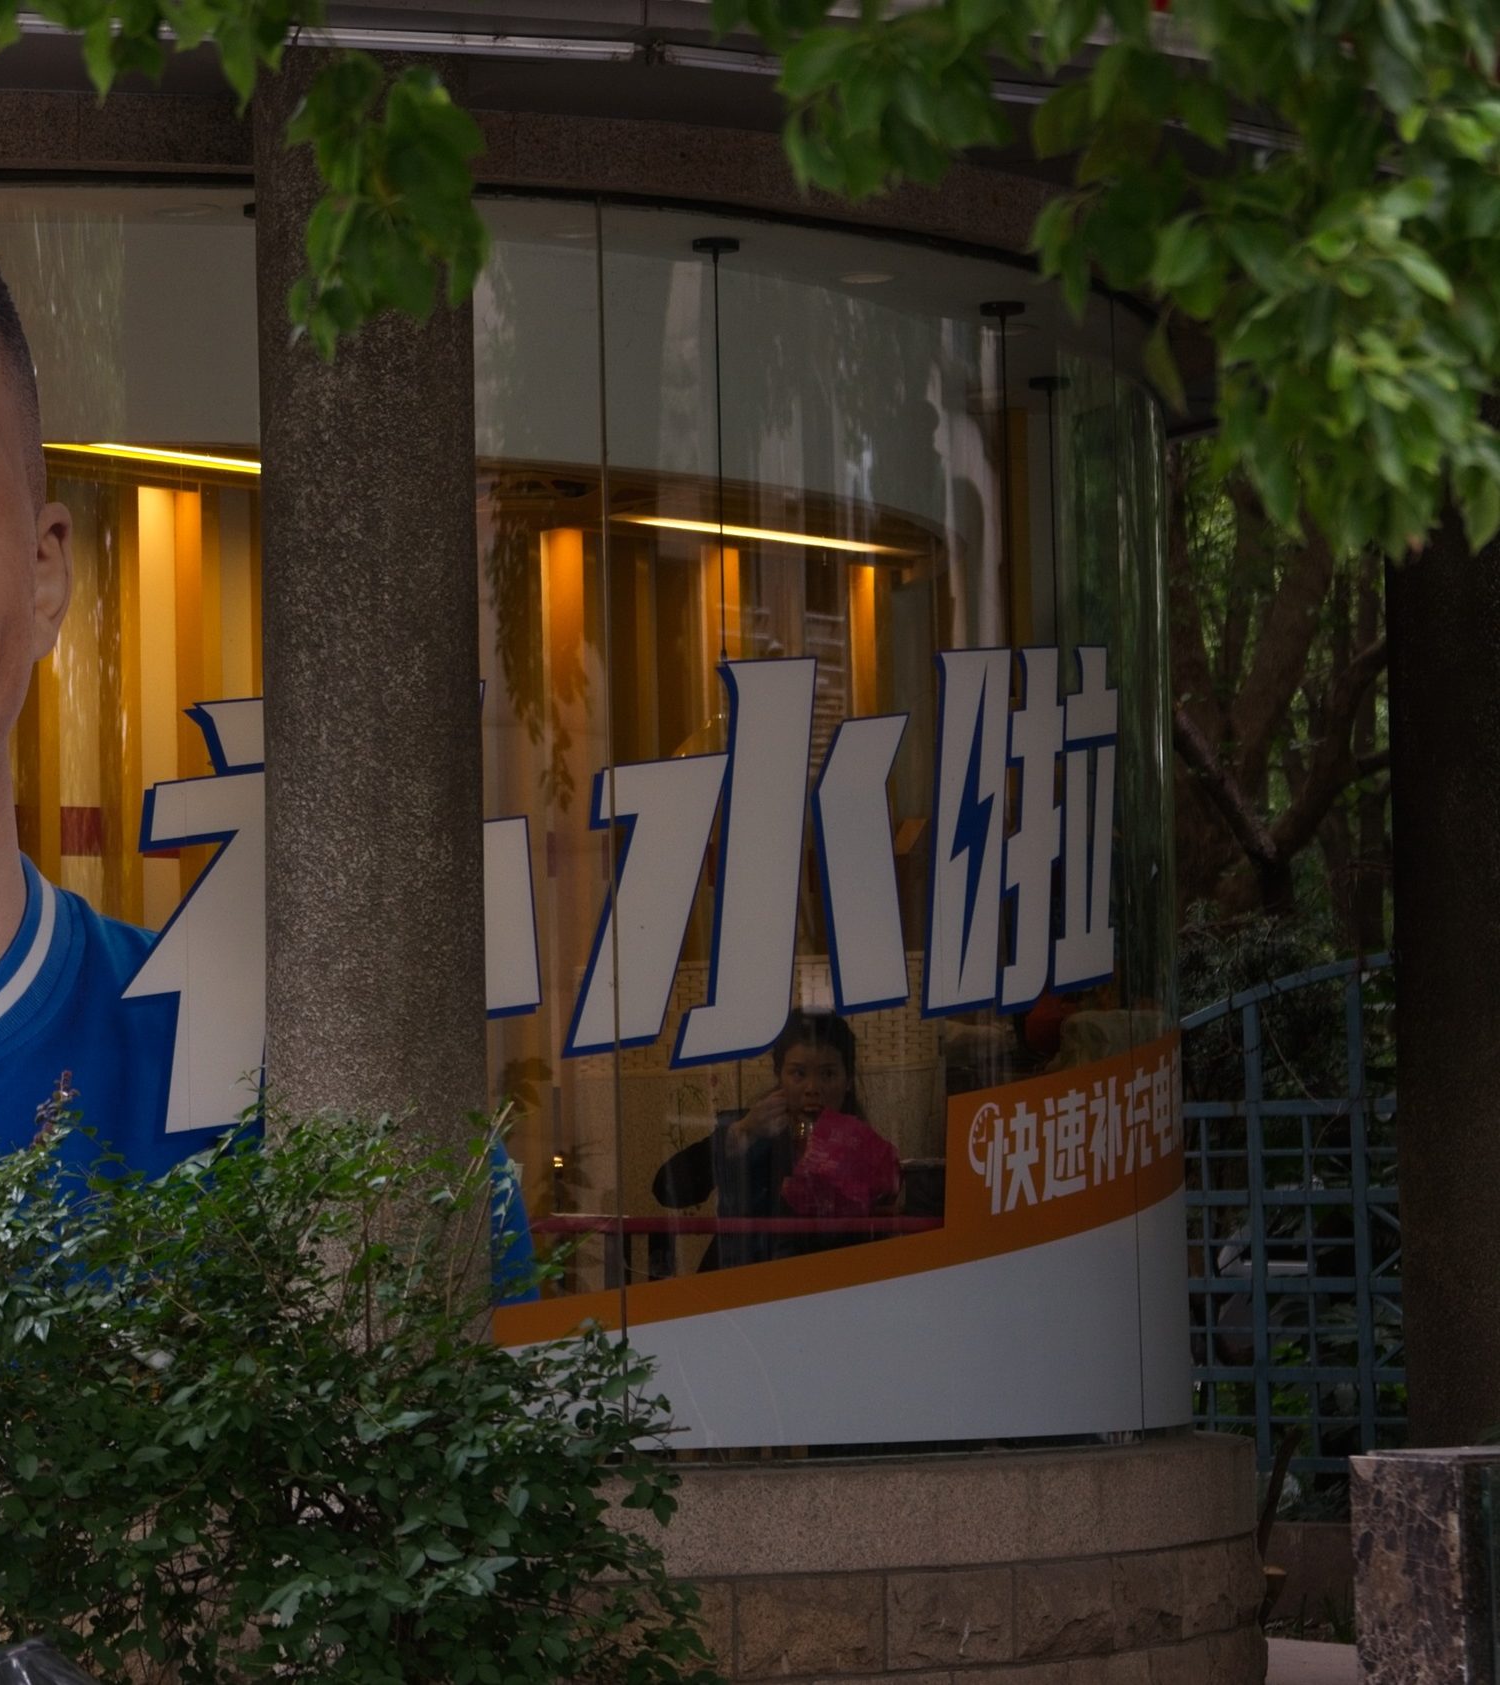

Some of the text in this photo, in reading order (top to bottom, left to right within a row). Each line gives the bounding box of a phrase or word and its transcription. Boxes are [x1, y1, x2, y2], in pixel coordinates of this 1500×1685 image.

[984, 1044, 1184, 1216] 快速补充电
